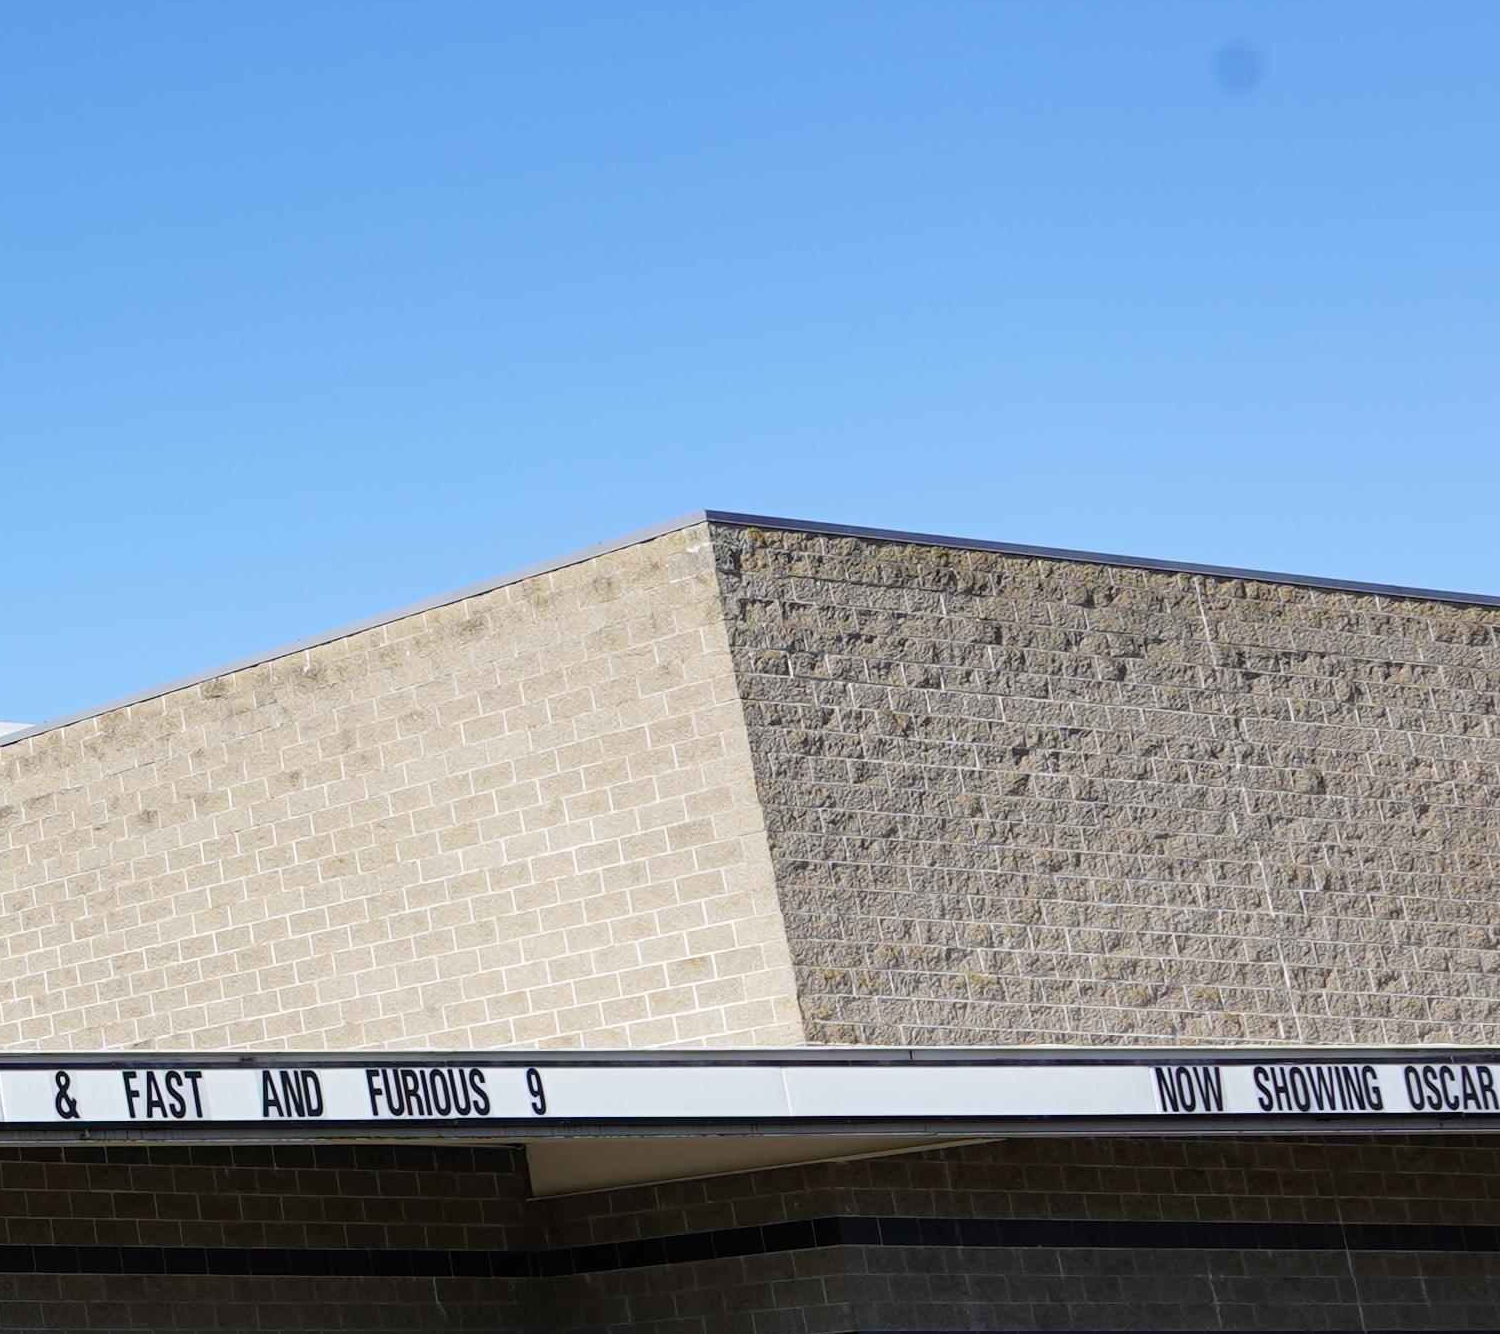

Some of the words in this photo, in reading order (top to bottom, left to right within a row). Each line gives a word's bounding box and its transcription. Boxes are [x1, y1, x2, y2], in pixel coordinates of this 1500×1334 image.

[55, 1071, 80, 1119] &
[123, 1070, 202, 1118] FAST
[263, 1070, 323, 1117] AND
[367, 1068, 490, 1116] FURIOUS
[526, 1068, 547, 1115] 9
[1155, 1065, 1223, 1112] NOW
[1254, 1066, 1383, 1112] SHOWING
[1404, 1066, 1499, 1110] OSCAR
